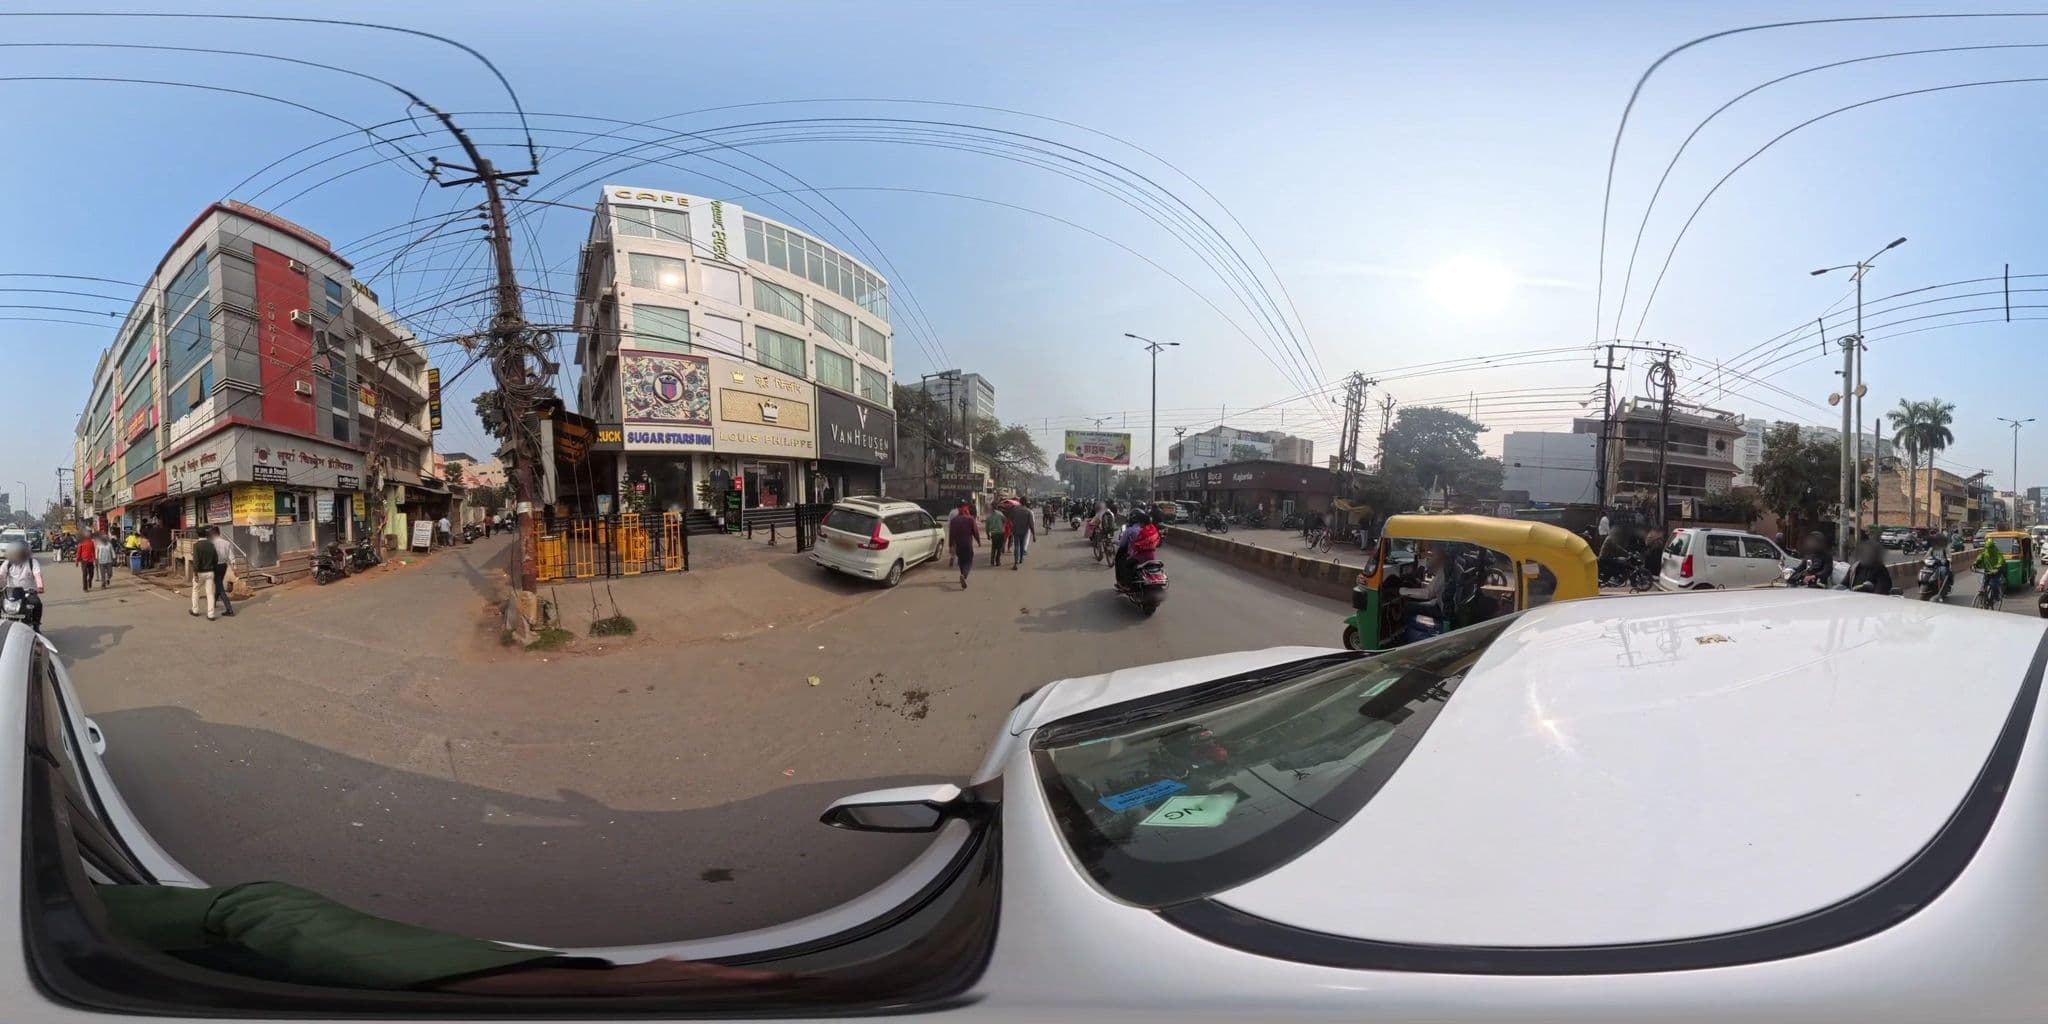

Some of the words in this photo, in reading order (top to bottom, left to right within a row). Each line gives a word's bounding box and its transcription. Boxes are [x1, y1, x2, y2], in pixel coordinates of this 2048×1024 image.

[615, 190, 689, 207] CAFE
[627, 431, 664, 444] SUGAR
[665, 432, 695, 446] STARS
[695, 434, 712, 446] INN
[719, 431, 759, 443] LOUIS
[764, 434, 814, 449] PHILIPPE
